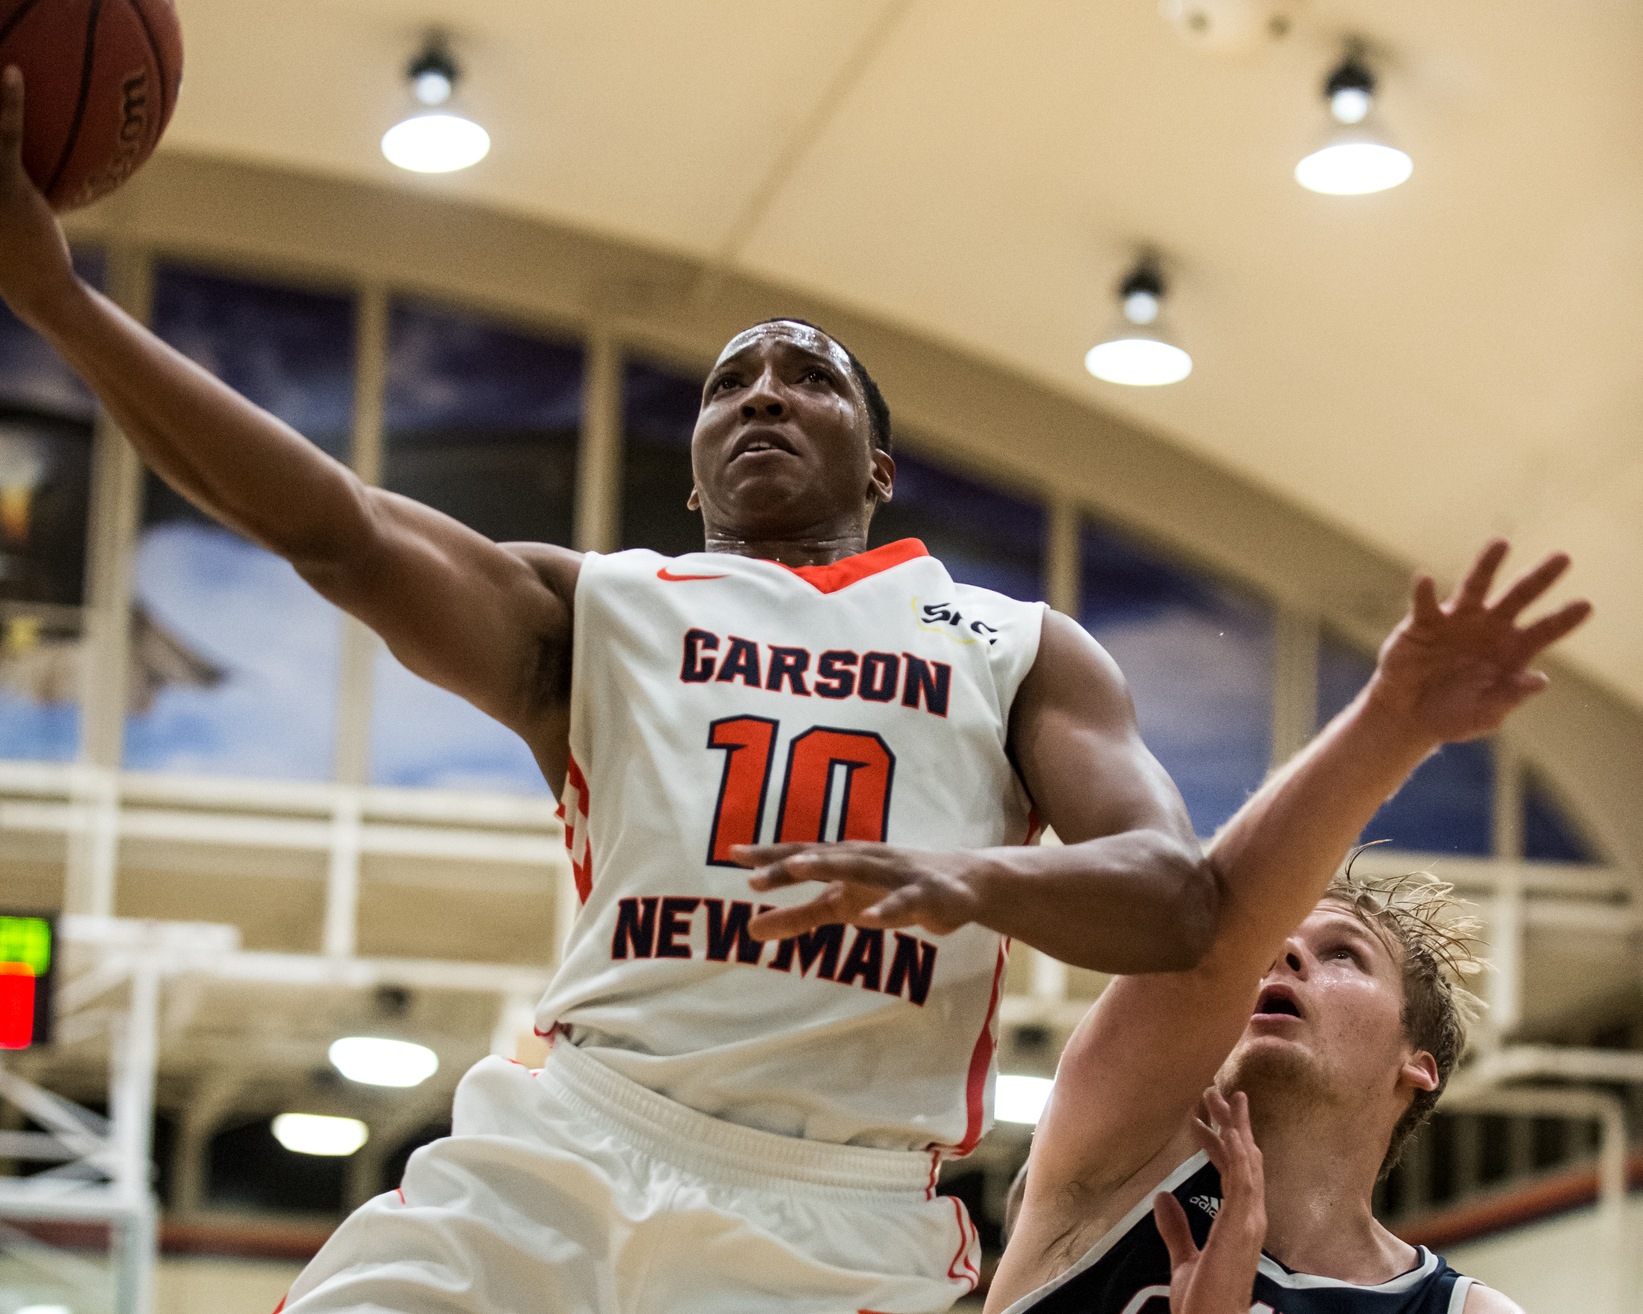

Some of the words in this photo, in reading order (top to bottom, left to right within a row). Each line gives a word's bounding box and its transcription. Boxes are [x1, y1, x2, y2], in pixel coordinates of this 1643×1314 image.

[680, 628, 952, 718] CARSON
[706, 713, 896, 870] 10
[612, 896, 938, 1008] NEWMAN
